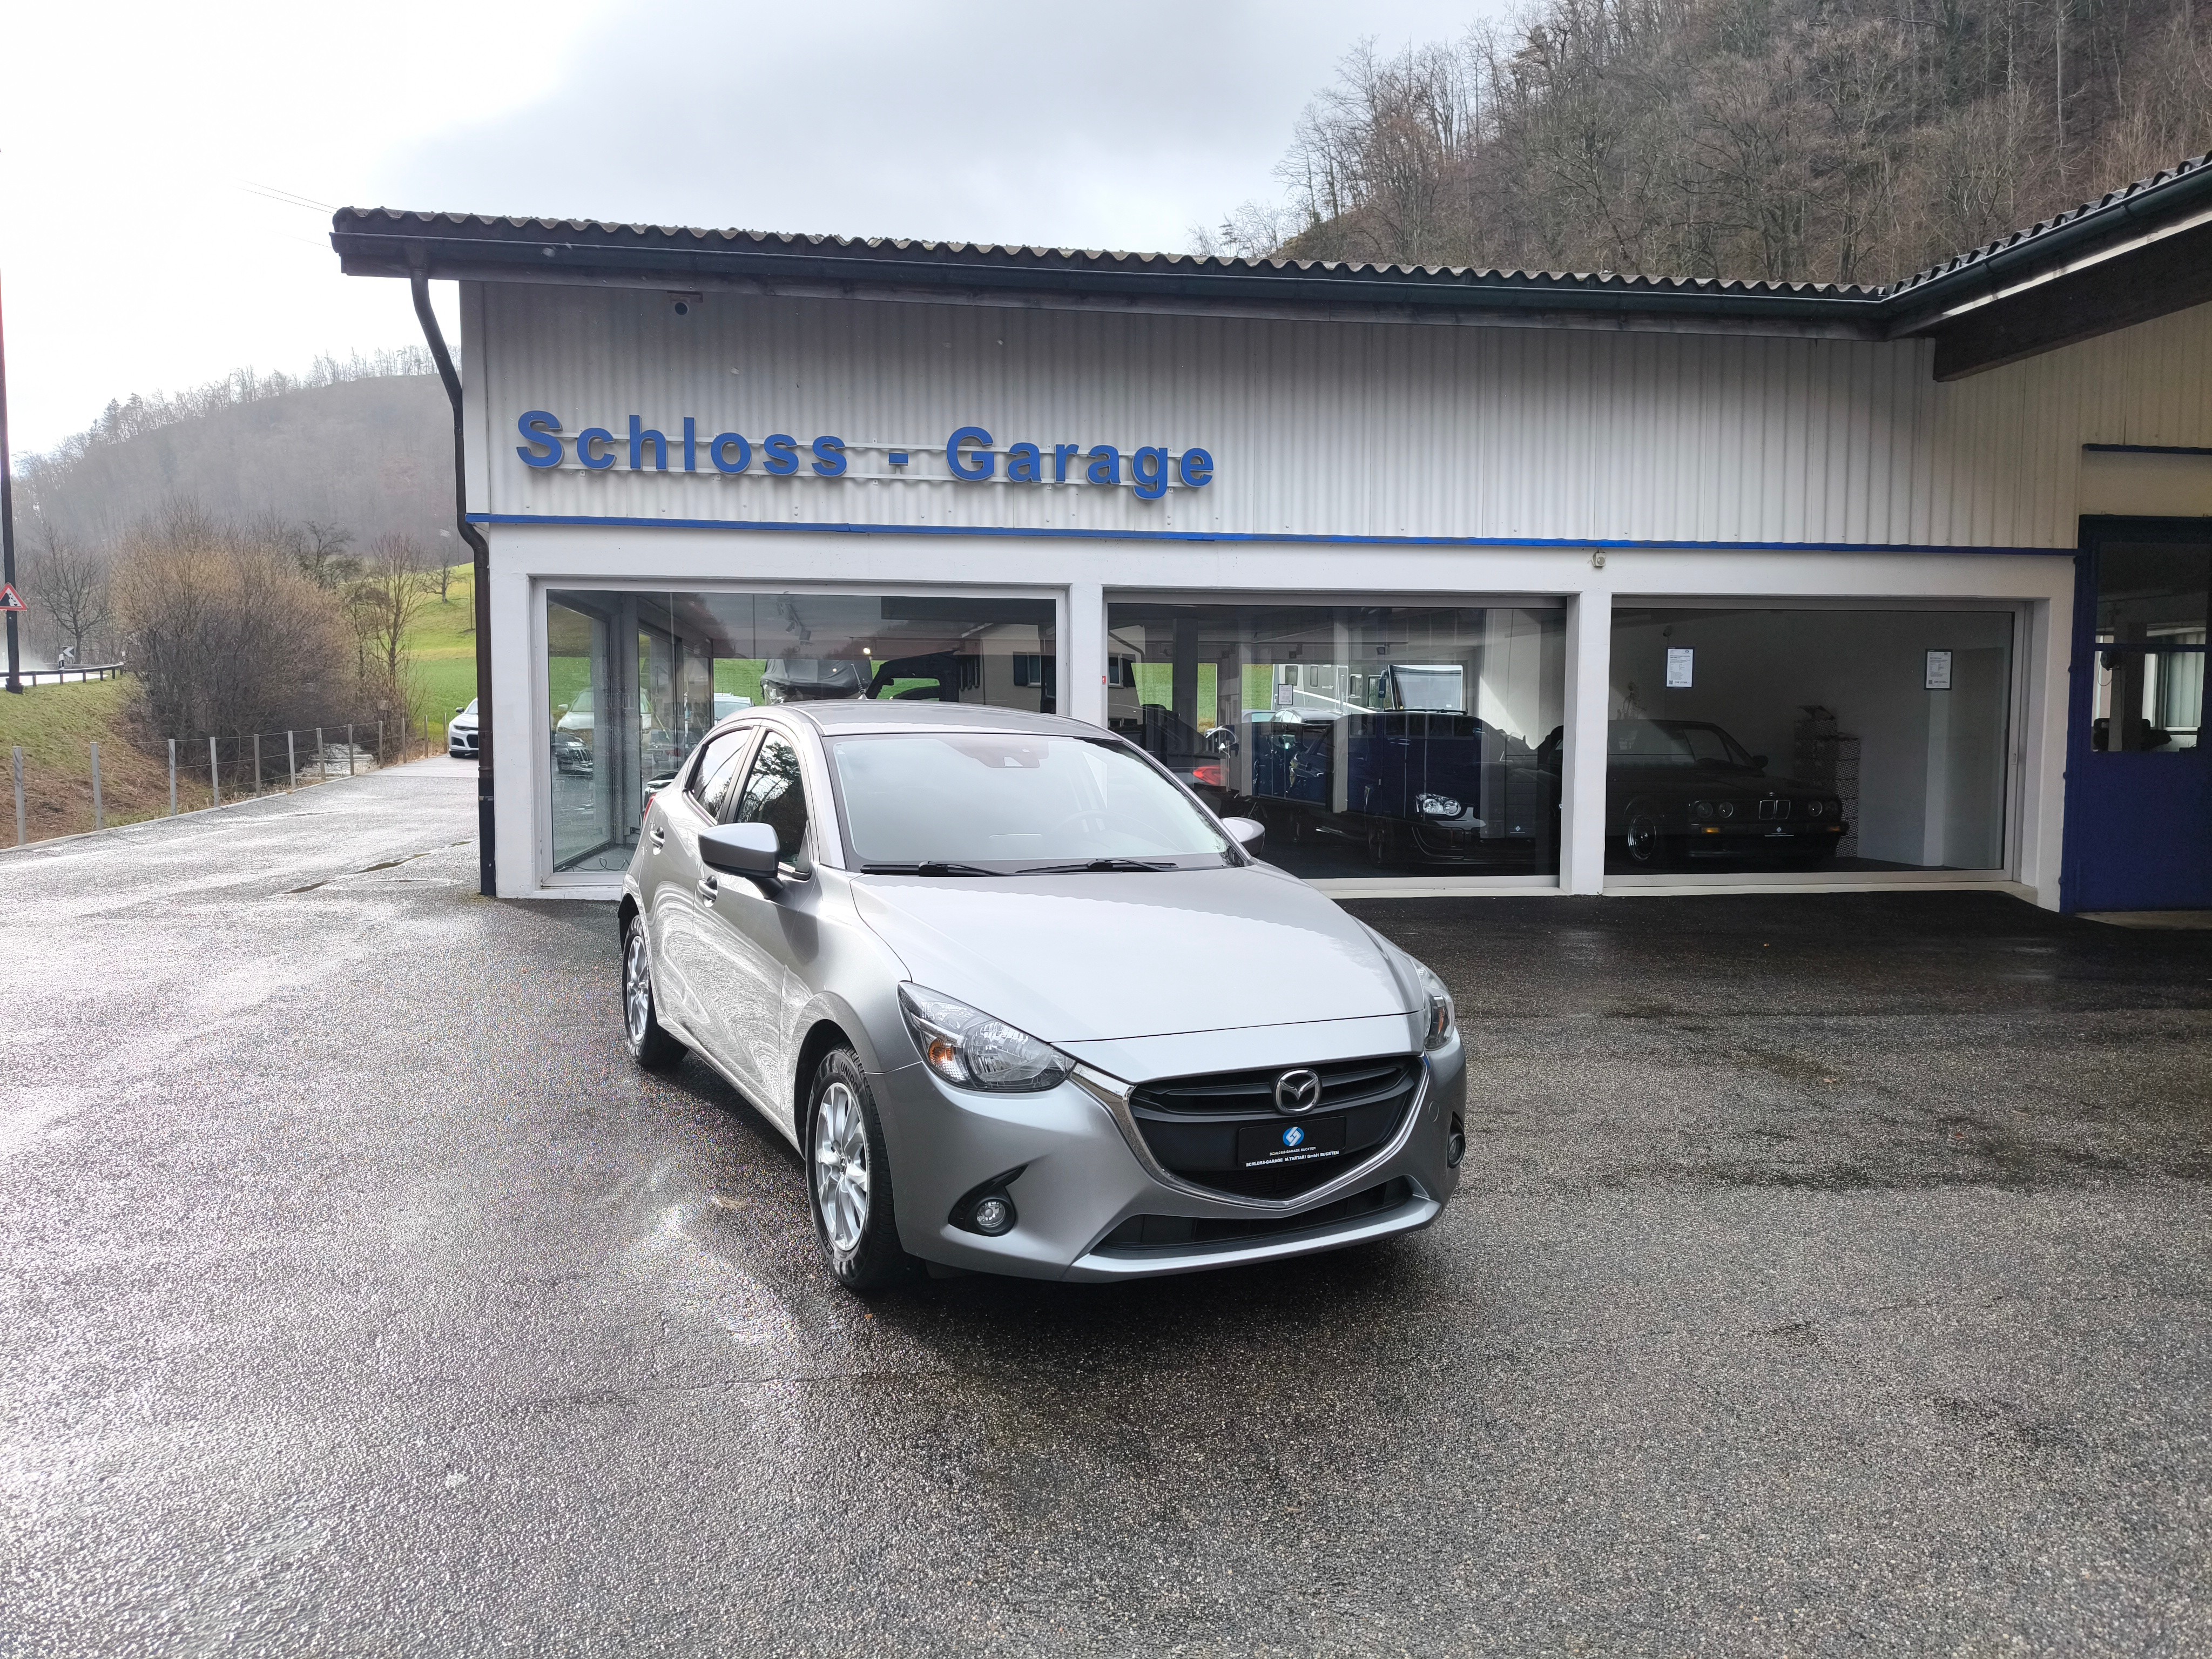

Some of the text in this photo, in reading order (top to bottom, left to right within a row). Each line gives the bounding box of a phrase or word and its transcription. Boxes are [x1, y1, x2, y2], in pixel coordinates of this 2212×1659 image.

[516, 410, 1215, 500] Schloss - Garage
[1246, 1158, 1283, 1167] SCHLOSS-GARAGE
